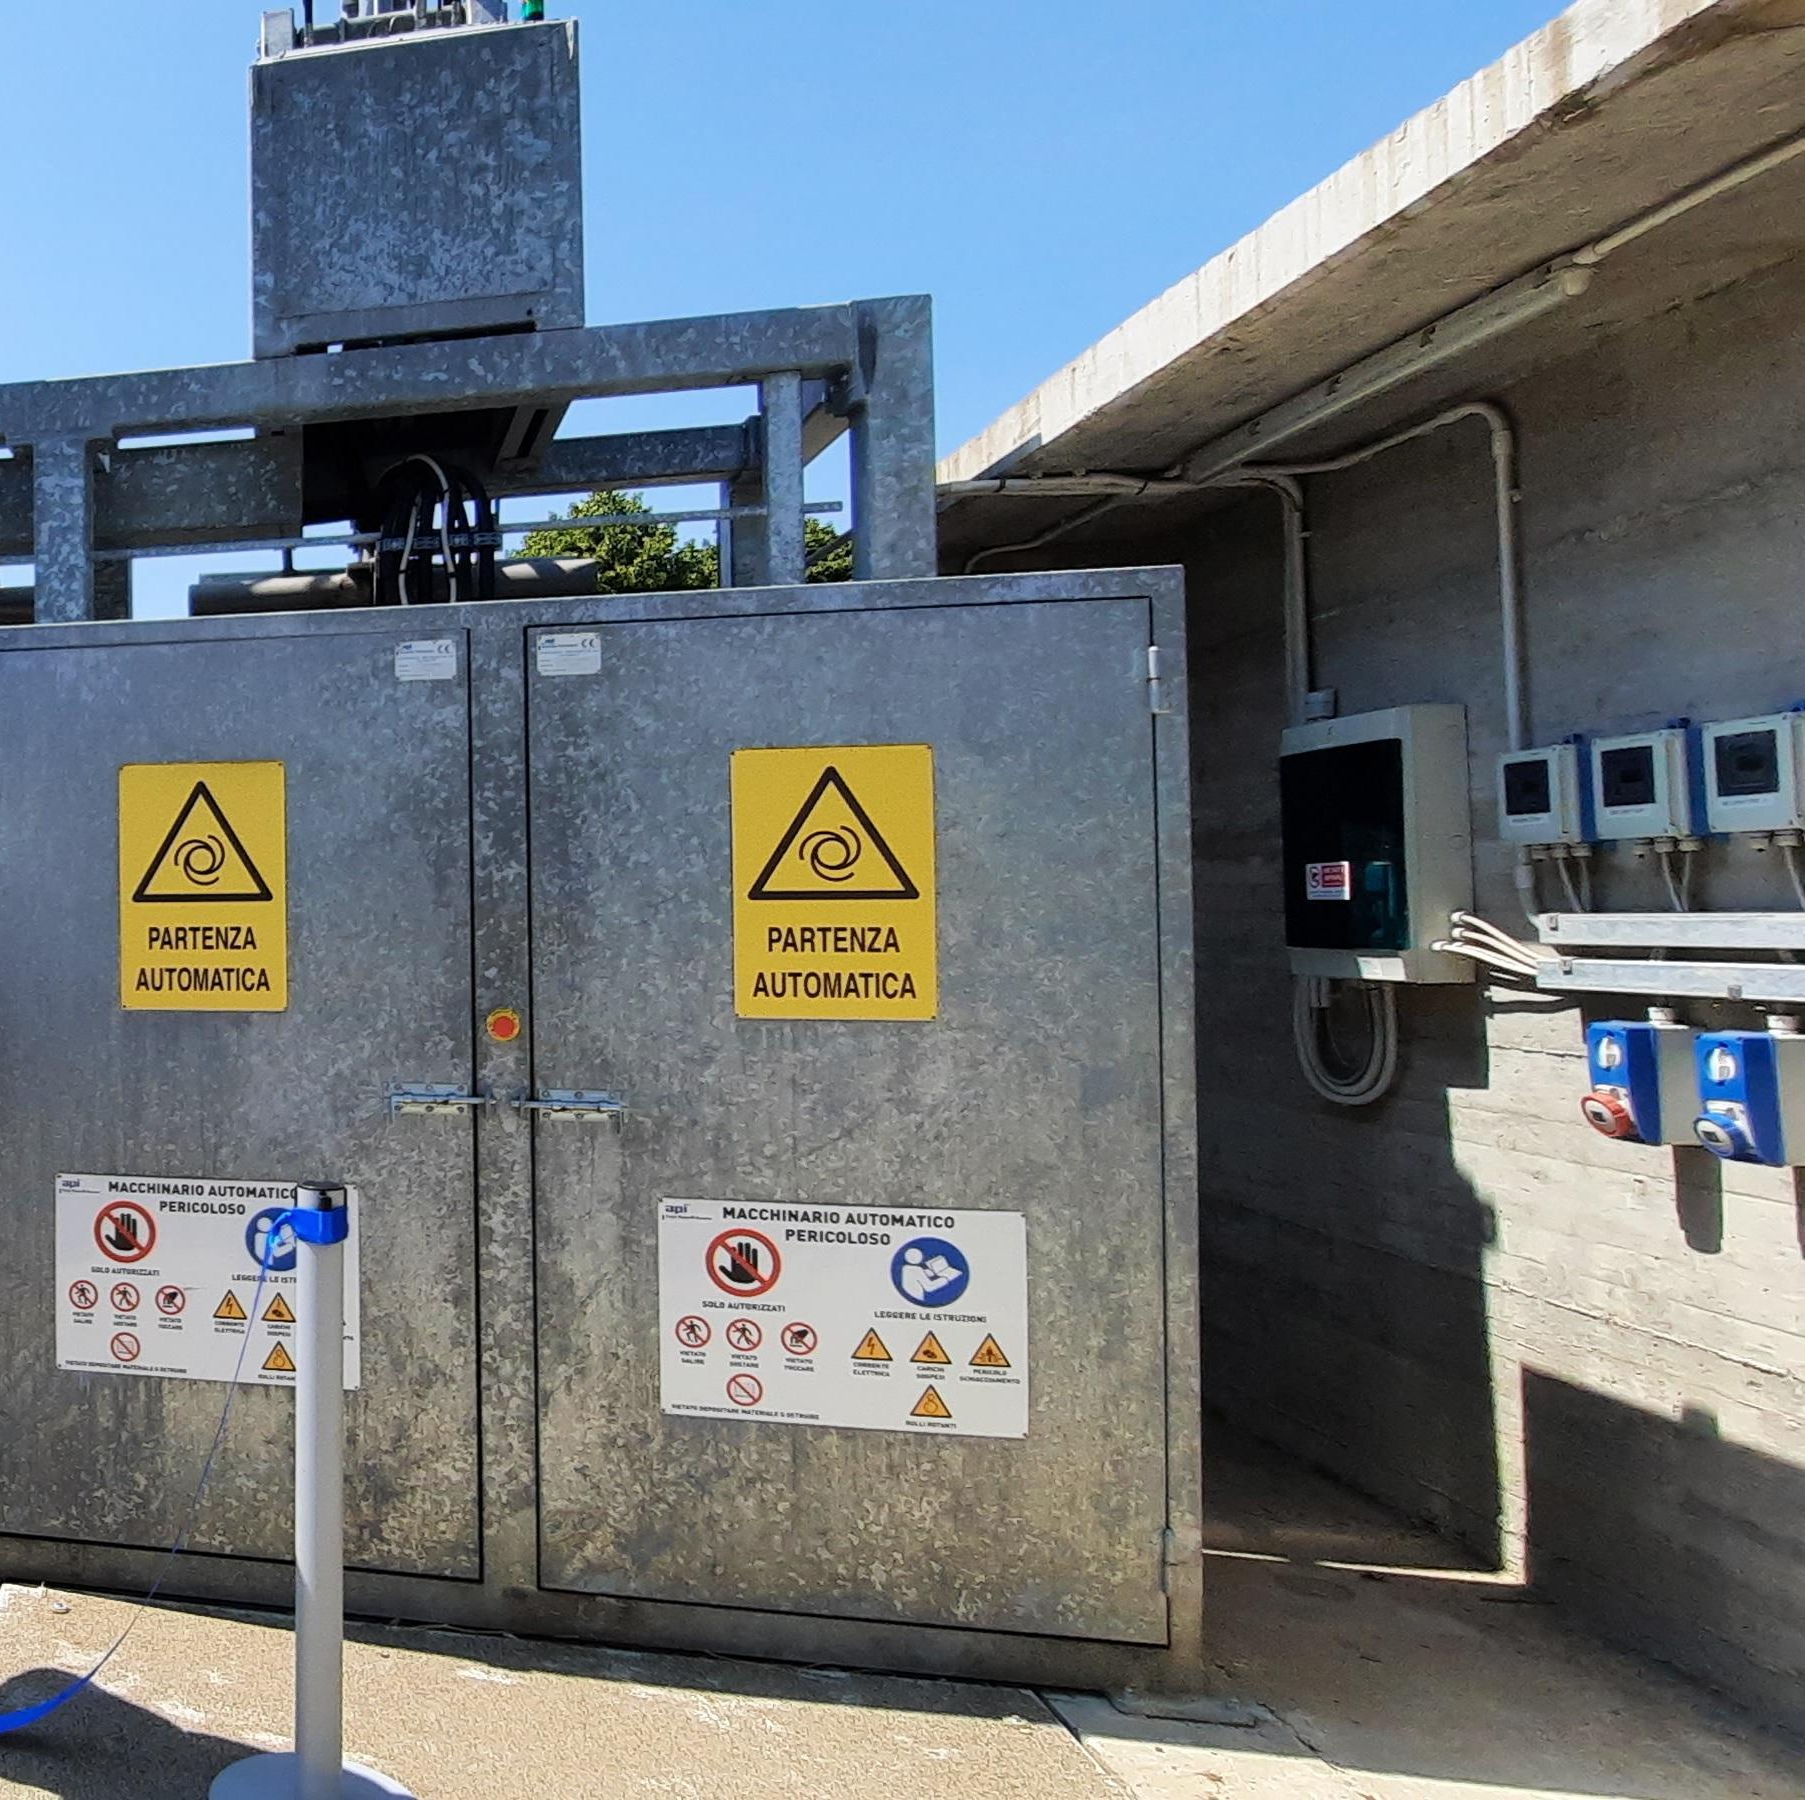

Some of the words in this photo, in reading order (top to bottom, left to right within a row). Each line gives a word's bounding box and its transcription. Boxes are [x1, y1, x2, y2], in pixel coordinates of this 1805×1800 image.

[148, 926, 257, 950] PARTENZA
[767, 926, 901, 953] PARTENZA
[135, 967, 271, 992] AUTOMATICA
[752, 971, 917, 999] AUTOMATICA
[108, 1180, 204, 1196] MACCHINARIO
[159, 1200, 245, 1215] PERICOLOSO
[722, 1207, 840, 1224] MACCHINARIO
[845, 1212, 955, 1229] AUTOMATICO
[785, 1229, 890, 1245] PERICOLOSO
[702, 1300, 725, 1309] SOLO
[727, 1302, 786, 1312] AUTORIZZATI
[874, 1311, 917, 1320] LEGGERE
[919, 1313, 930, 1321] LE
[933, 1313, 987, 1323] ISTRUZIONI
